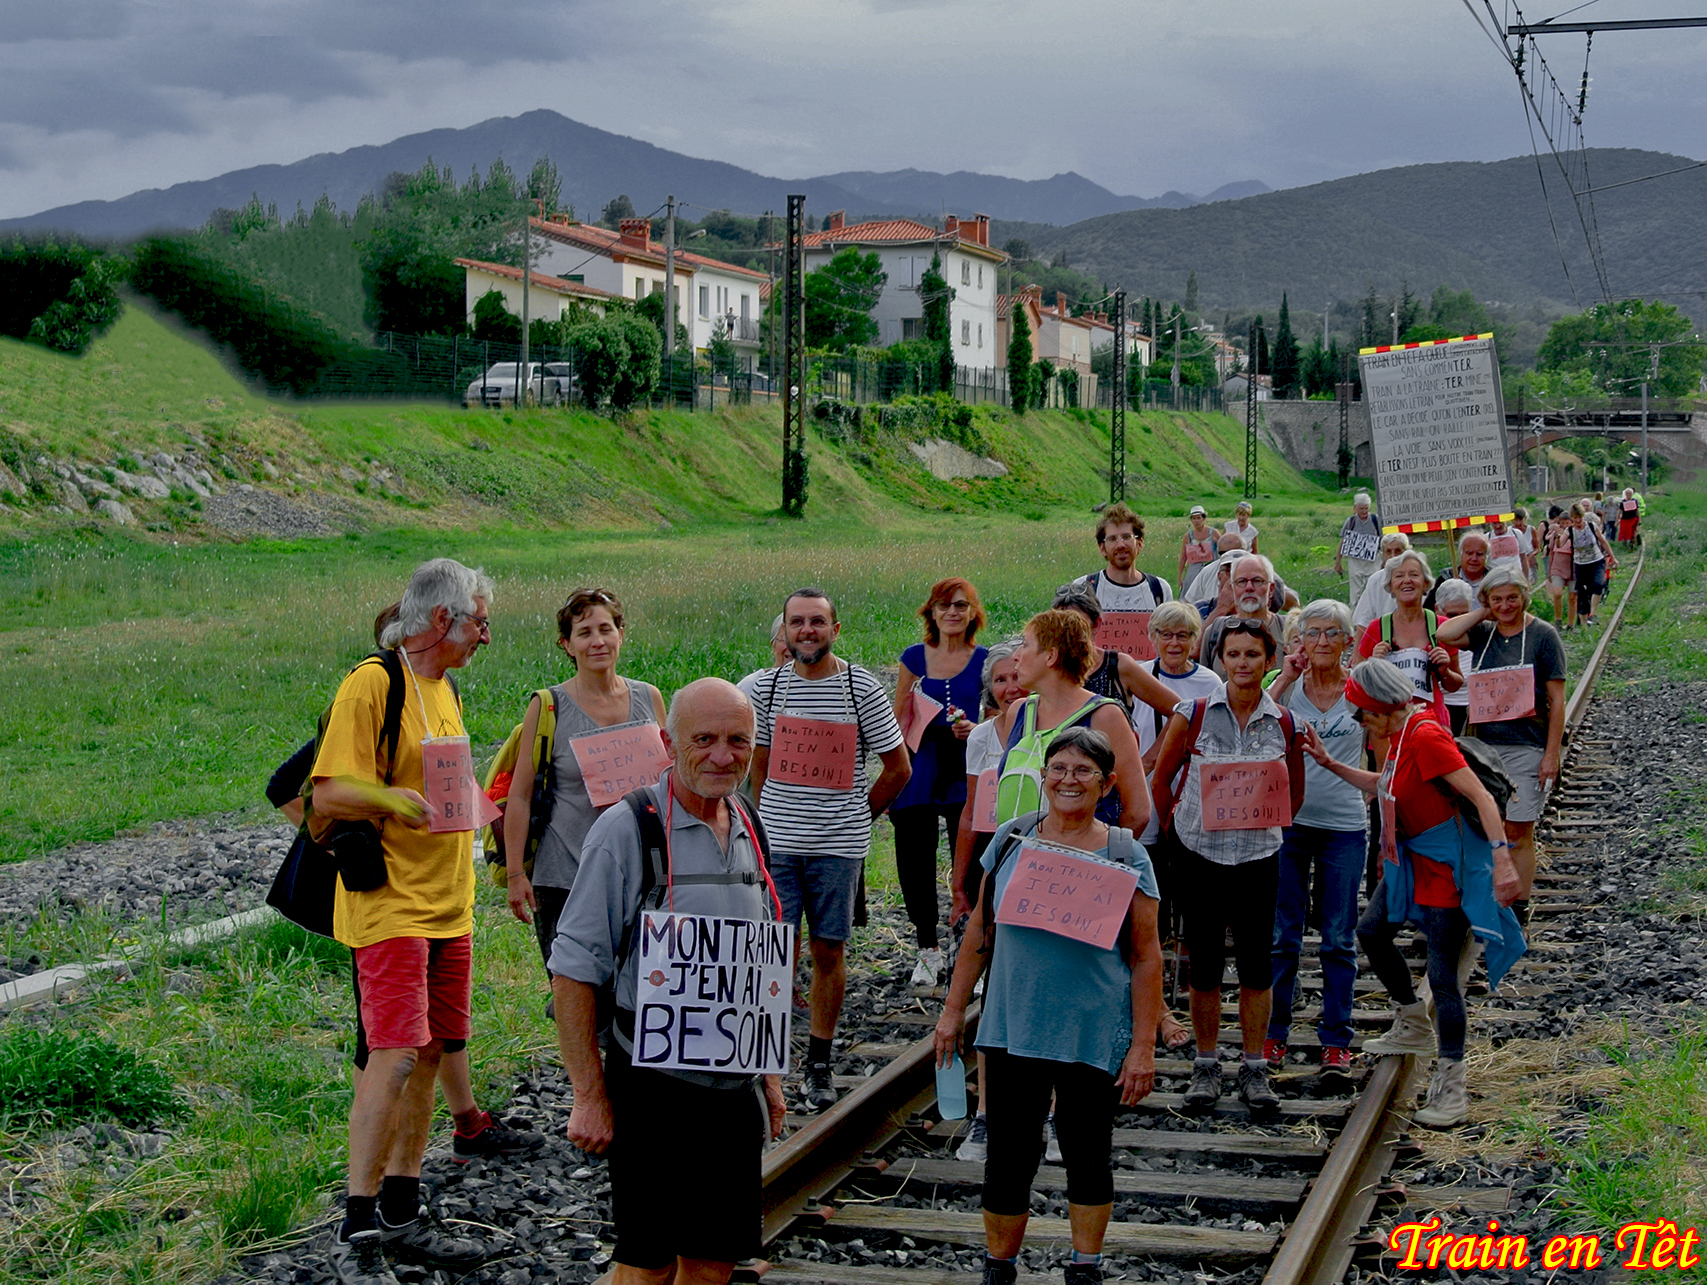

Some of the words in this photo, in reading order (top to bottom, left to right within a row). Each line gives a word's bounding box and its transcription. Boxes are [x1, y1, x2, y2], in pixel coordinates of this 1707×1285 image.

[1400, 364, 1422, 379] SANS
[1370, 384, 1392, 398] TRAIN
[1403, 382, 1412, 394] LA
[1372, 416, 1381, 429] LE
[1383, 414, 1398, 427] CAR
[1388, 427, 1409, 441] SANS
[1410, 426, 1425, 438] RAIL
[1428, 424, 1439, 436] ON
[1392, 444, 1403, 456] LA
[1404, 441, 1422, 454] VOIE
[1426, 439, 1445, 452] SANS
[1377, 460, 1386, 473] LE
[1386, 458, 1402, 472] TER
[1421, 454, 1437, 468] PLUS
[1462, 451, 1472, 462] EN
[1379, 475, 1394, 488] SANS
[1395, 473, 1410, 485] TRAIN
[1411, 473, 1420, 484] ON
[1420, 472, 1427, 483] NE
[1427, 470, 1443, 482] PEUT
[1380, 491, 1388, 502] LE
[1388, 488, 1411, 502] PEUPLE
[1412, 488, 1420, 499] NE
[1421, 487, 1437, 498] VEUT
[1436, 486, 1447, 496] PAS
[1460, 483, 1480, 494] LAISSER
[1481, 480, 1507, 491] CONTER
[1383, 504, 1393, 516] UN
[1394, 502, 1410, 514] TRAIN
[1410, 501, 1425, 513] PEUT
[1425, 500, 1434, 511] EN
[1434, 498, 1461, 510] SCOTCHER
[1462, 496, 1477, 507] PLEIN
[1342, 545, 1375, 560] BESOIN
[781, 725, 798, 735] MON
[802, 727, 834, 736] TRAIN
[587, 746, 608, 756] MON
[610, 735, 642, 749] TRAIN
[647, 744, 660, 758] AI
[831, 742, 844, 754] AI
[437, 758, 457, 768] MON
[1210, 773, 1230, 782] MON
[1235, 768, 1268, 780] TRAIN
[1267, 780, 1279, 792] AI
[1027, 860, 1053, 874] MON
[1060, 864, 1103, 882] TRAIN
[1025, 877, 1077, 896] J'EN
[1093, 893, 1112, 906] AI
[642, 914, 721, 962] MON
[724, 919, 788, 967] TRAIN
[669, 962, 738, 1004] J'EN
[742, 965, 762, 1006] AI
[638, 1003, 786, 1069] BESOIN
